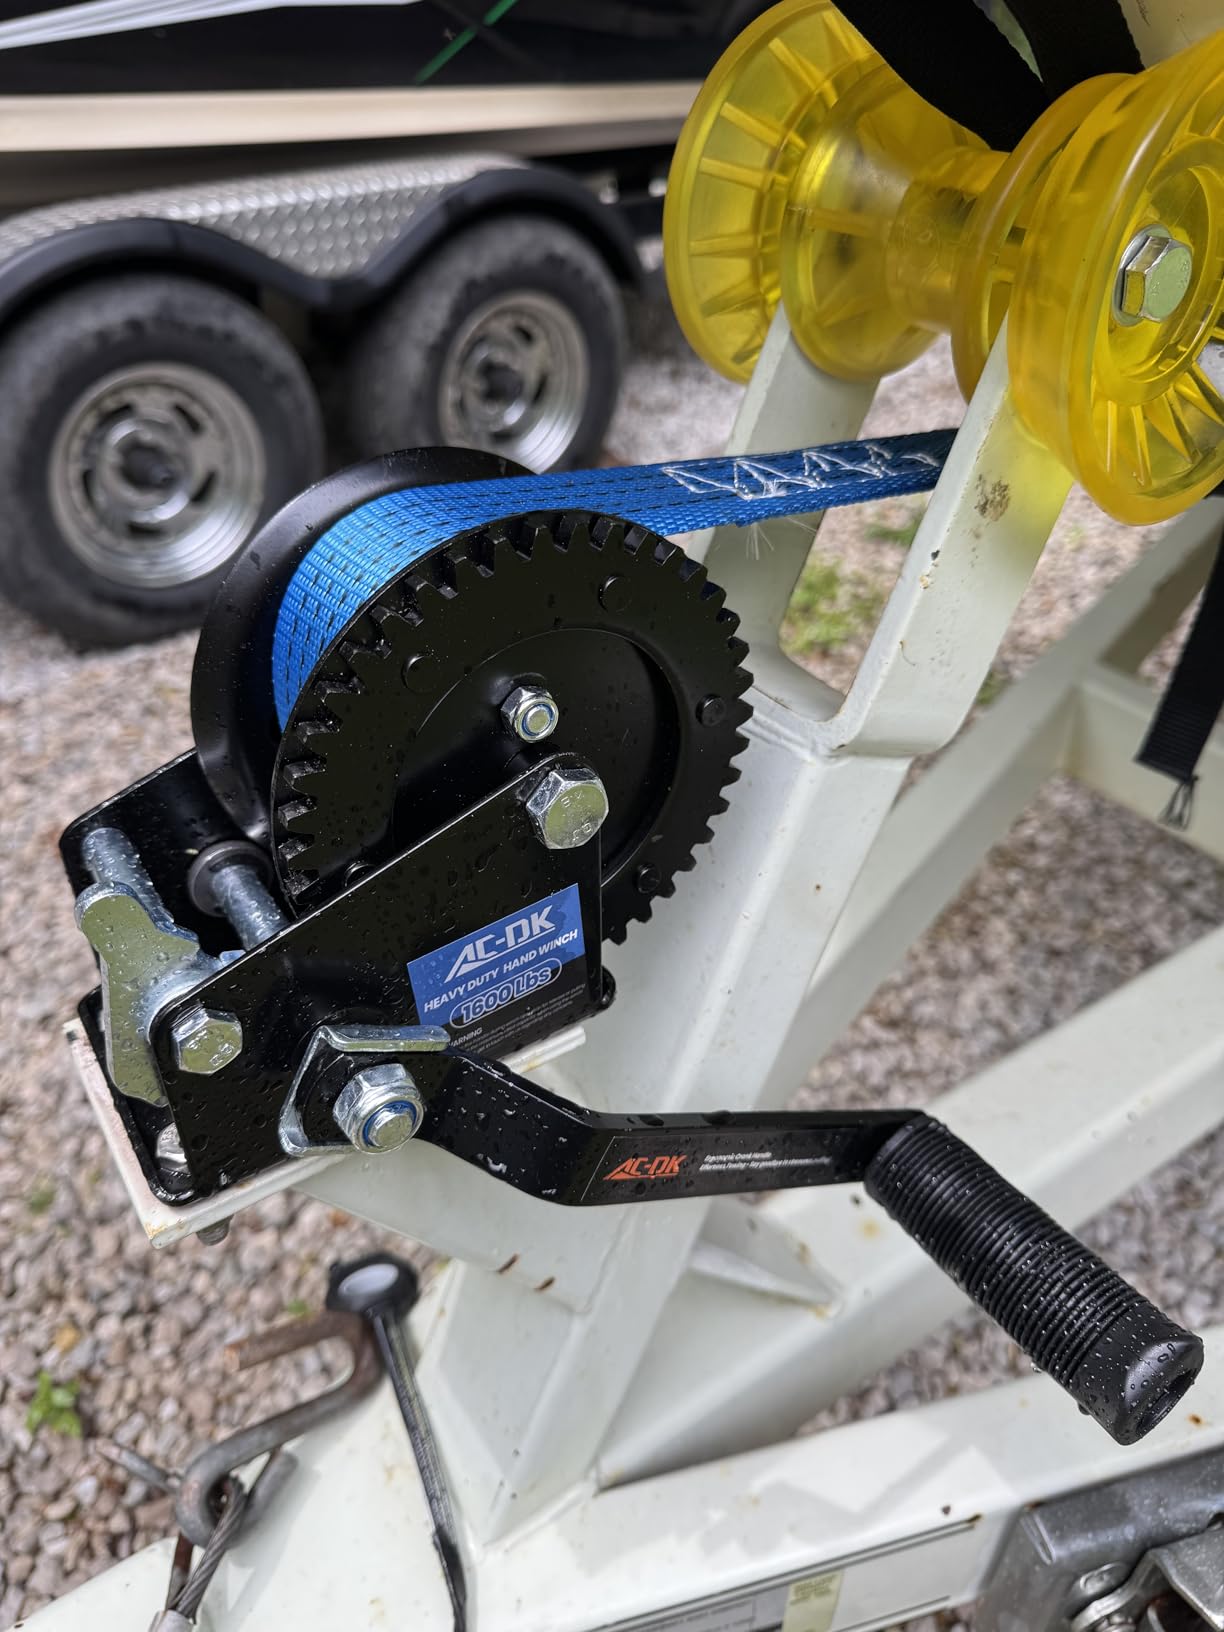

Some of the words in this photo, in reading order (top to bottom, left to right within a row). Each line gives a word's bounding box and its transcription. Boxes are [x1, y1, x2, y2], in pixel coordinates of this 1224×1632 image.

[424, 984, 466, 1013] HEAVY
[467, 967, 499, 991] DUTY
[503, 951, 537, 973] HAND
[538, 928, 578, 955] WINCH
[444, 904, 556, 984] AC-DK
[460, 983, 514, 1024] 1600
[513, 967, 552, 998] Lbs
[602, 1154, 687, 1180] AC-DK
